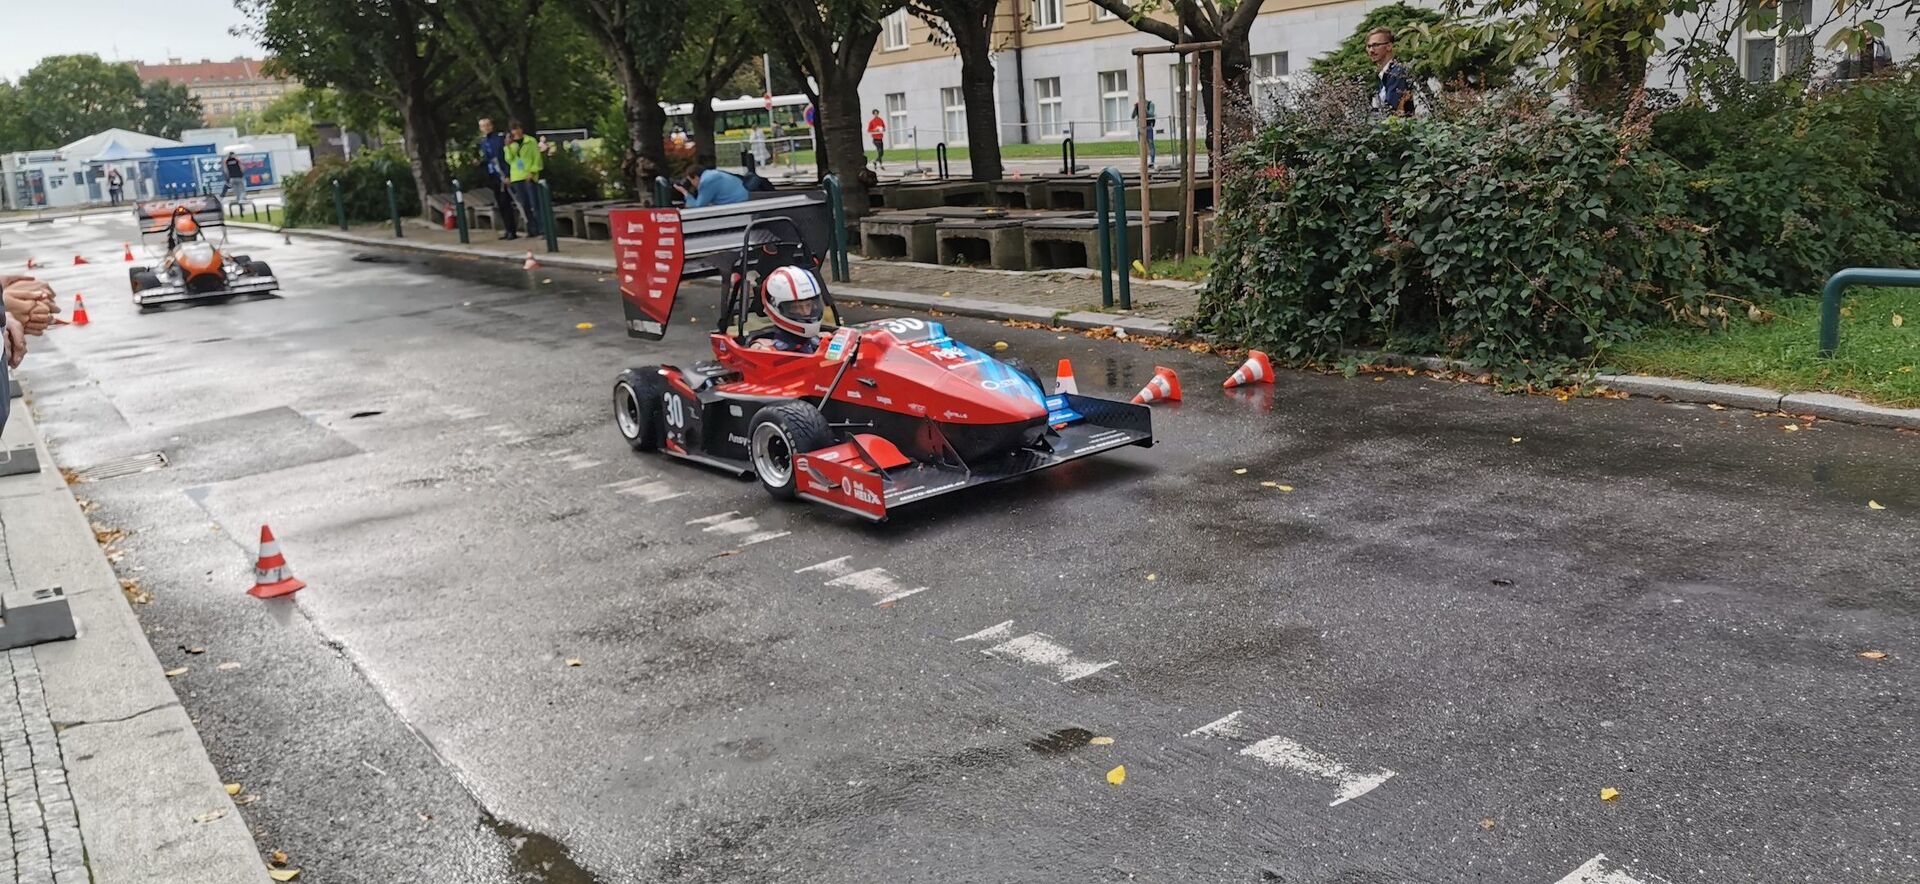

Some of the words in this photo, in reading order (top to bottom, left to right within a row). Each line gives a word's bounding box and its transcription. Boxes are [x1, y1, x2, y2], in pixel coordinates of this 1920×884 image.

[878, 317, 924, 333] 30
[664, 391, 684, 428] 30
[728, 433, 749, 447] Ansy
[854, 488, 882, 505] HELIX
